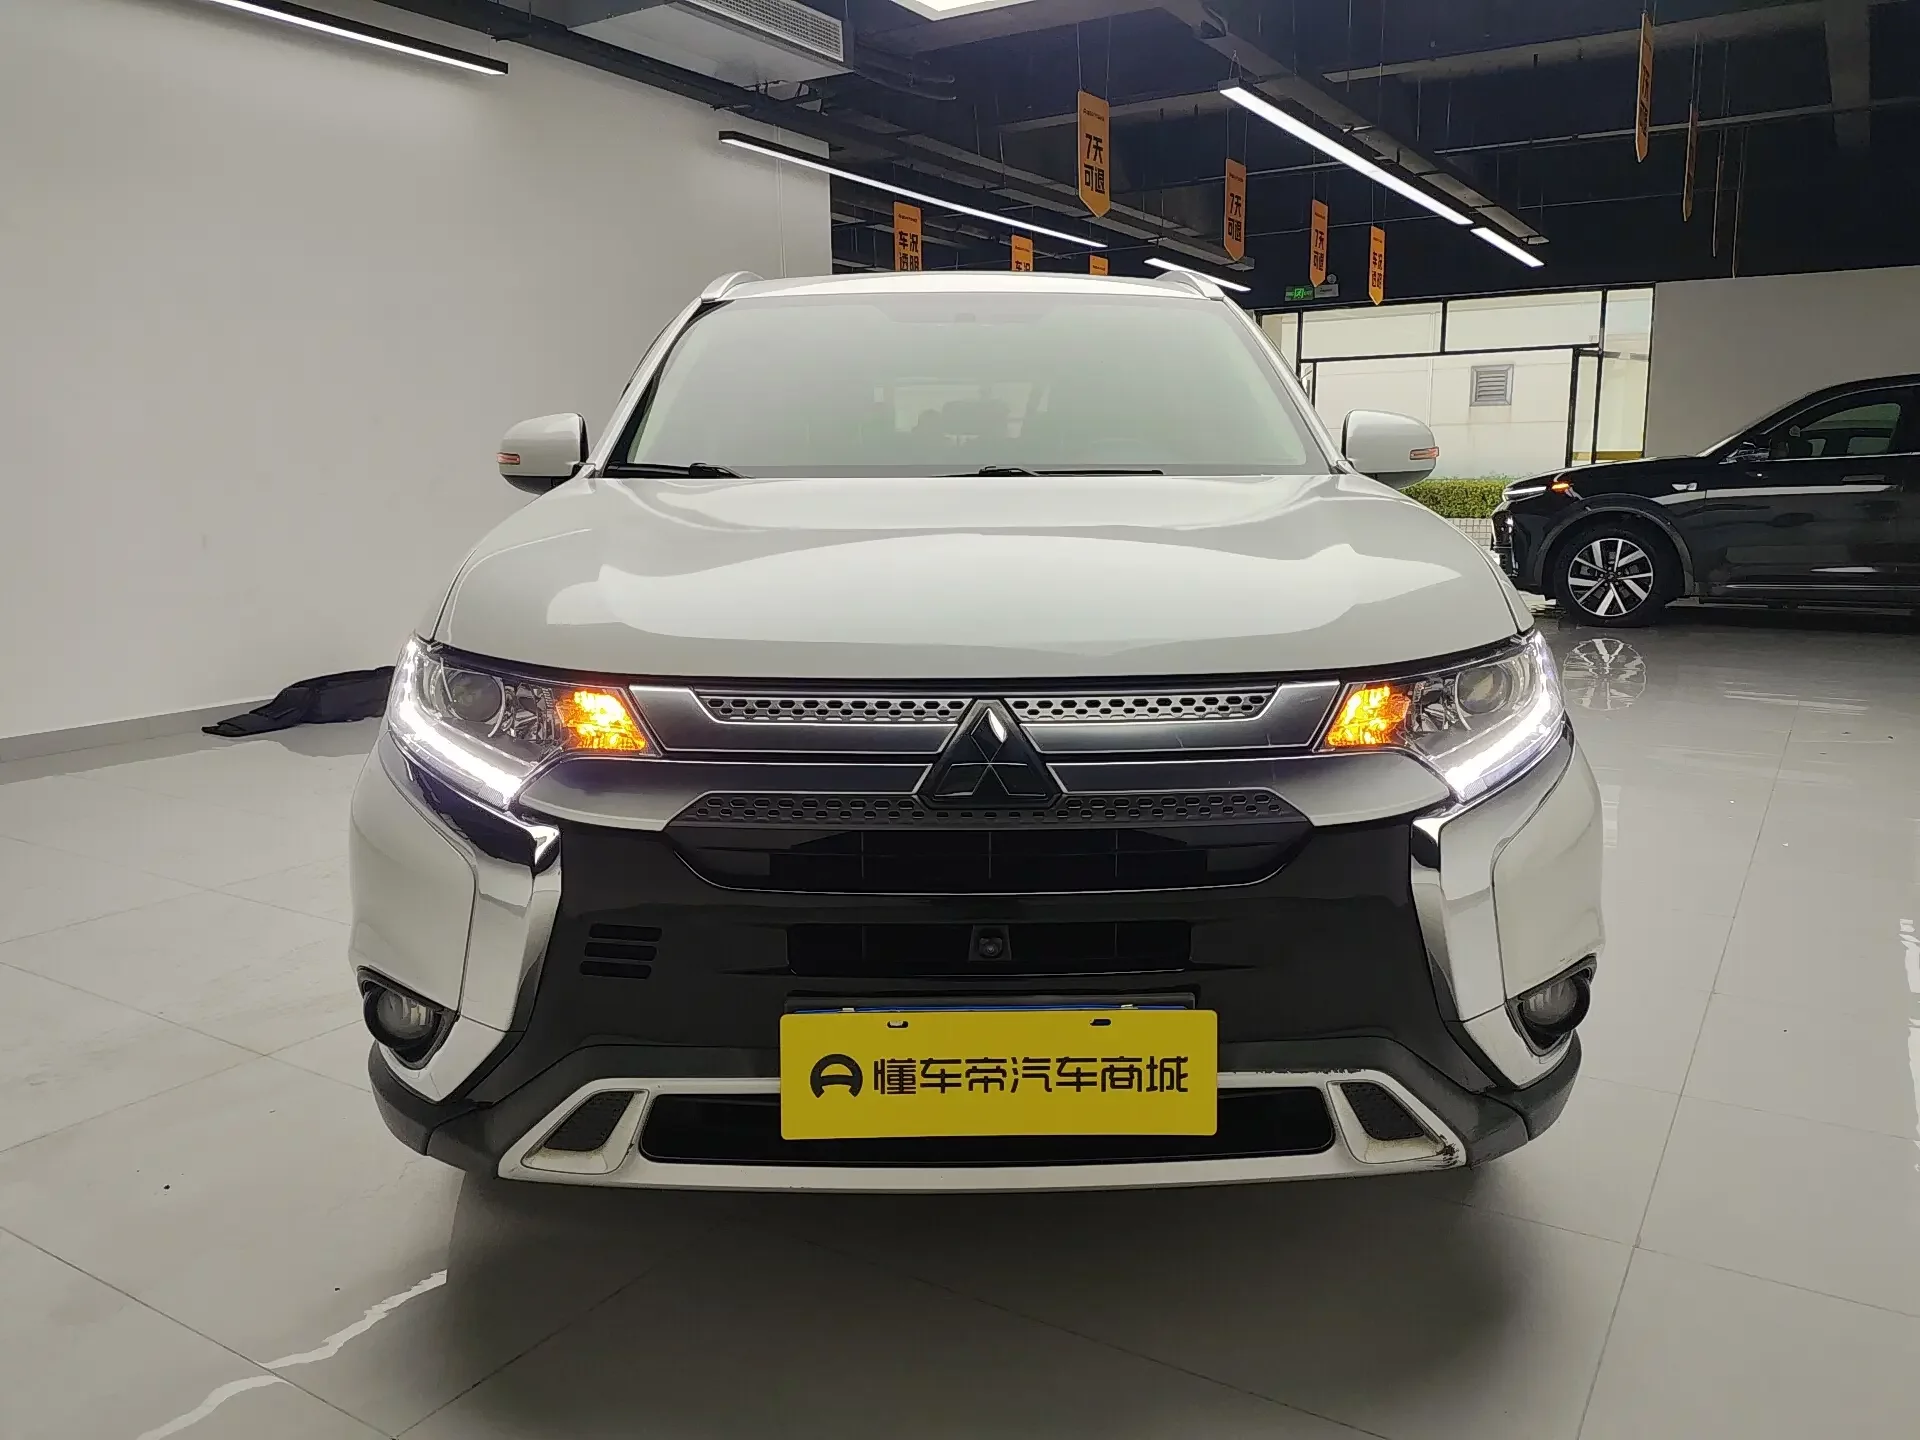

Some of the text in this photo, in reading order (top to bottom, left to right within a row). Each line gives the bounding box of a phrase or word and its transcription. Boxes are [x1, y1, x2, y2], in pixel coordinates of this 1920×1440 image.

[1085, 133, 1104, 164] 7天
[1084, 163, 1105, 194] 可退
[873, 1056, 1188, 1095] 懂车帝汽车商城
